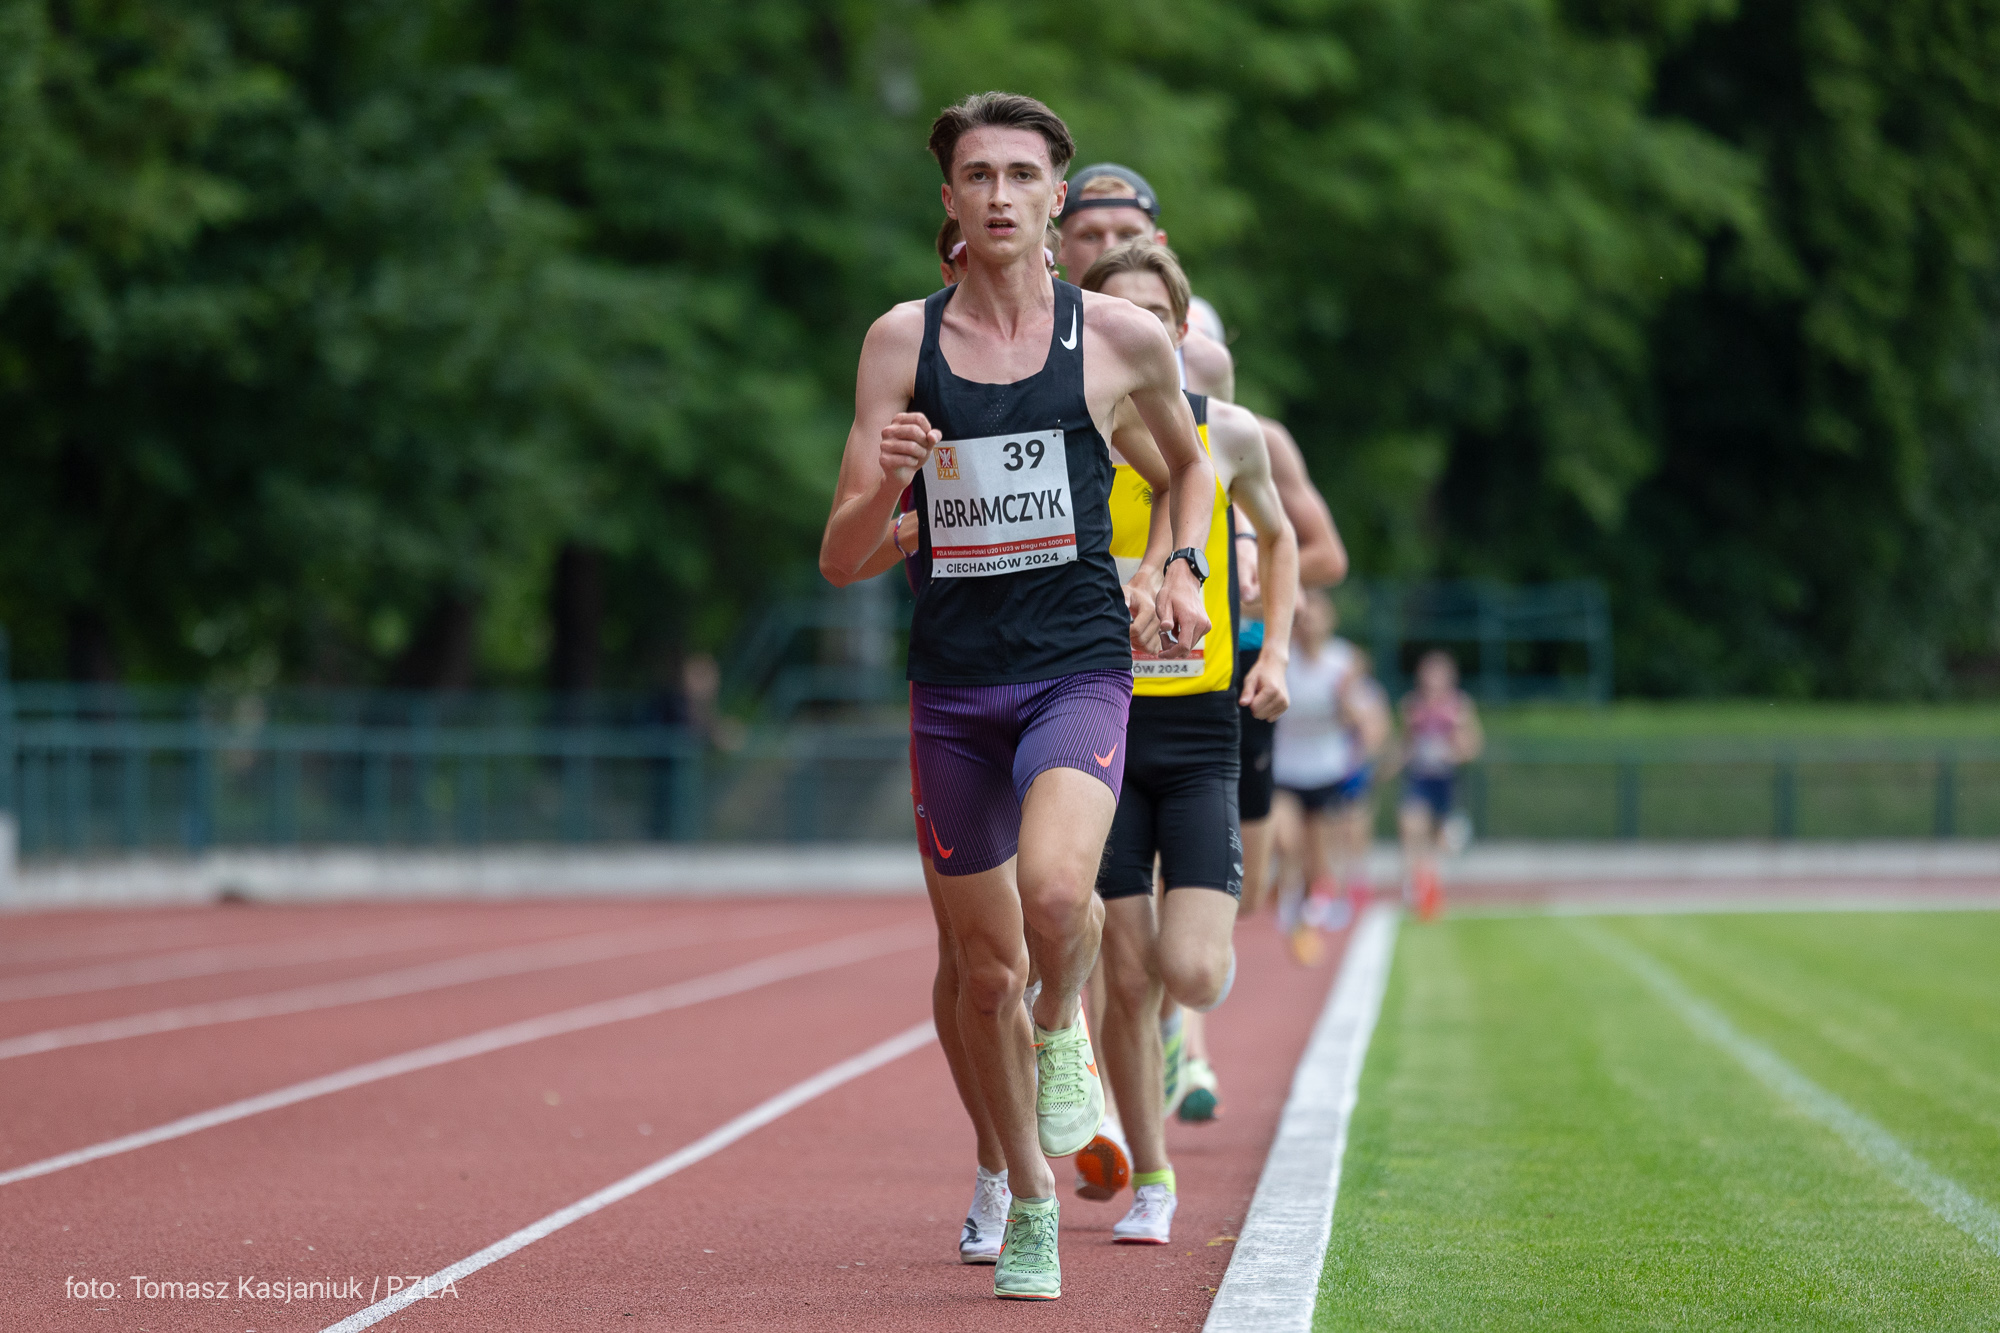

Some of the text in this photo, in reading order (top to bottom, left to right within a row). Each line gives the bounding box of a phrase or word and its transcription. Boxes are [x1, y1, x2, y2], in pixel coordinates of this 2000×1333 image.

[1002, 439, 1045, 471] 39
[934, 488, 1066, 528] ABRAMCZYK
[946, 552, 1059, 573] CIECHANÓW 2024
[1158, 664, 1188, 673] 2024
